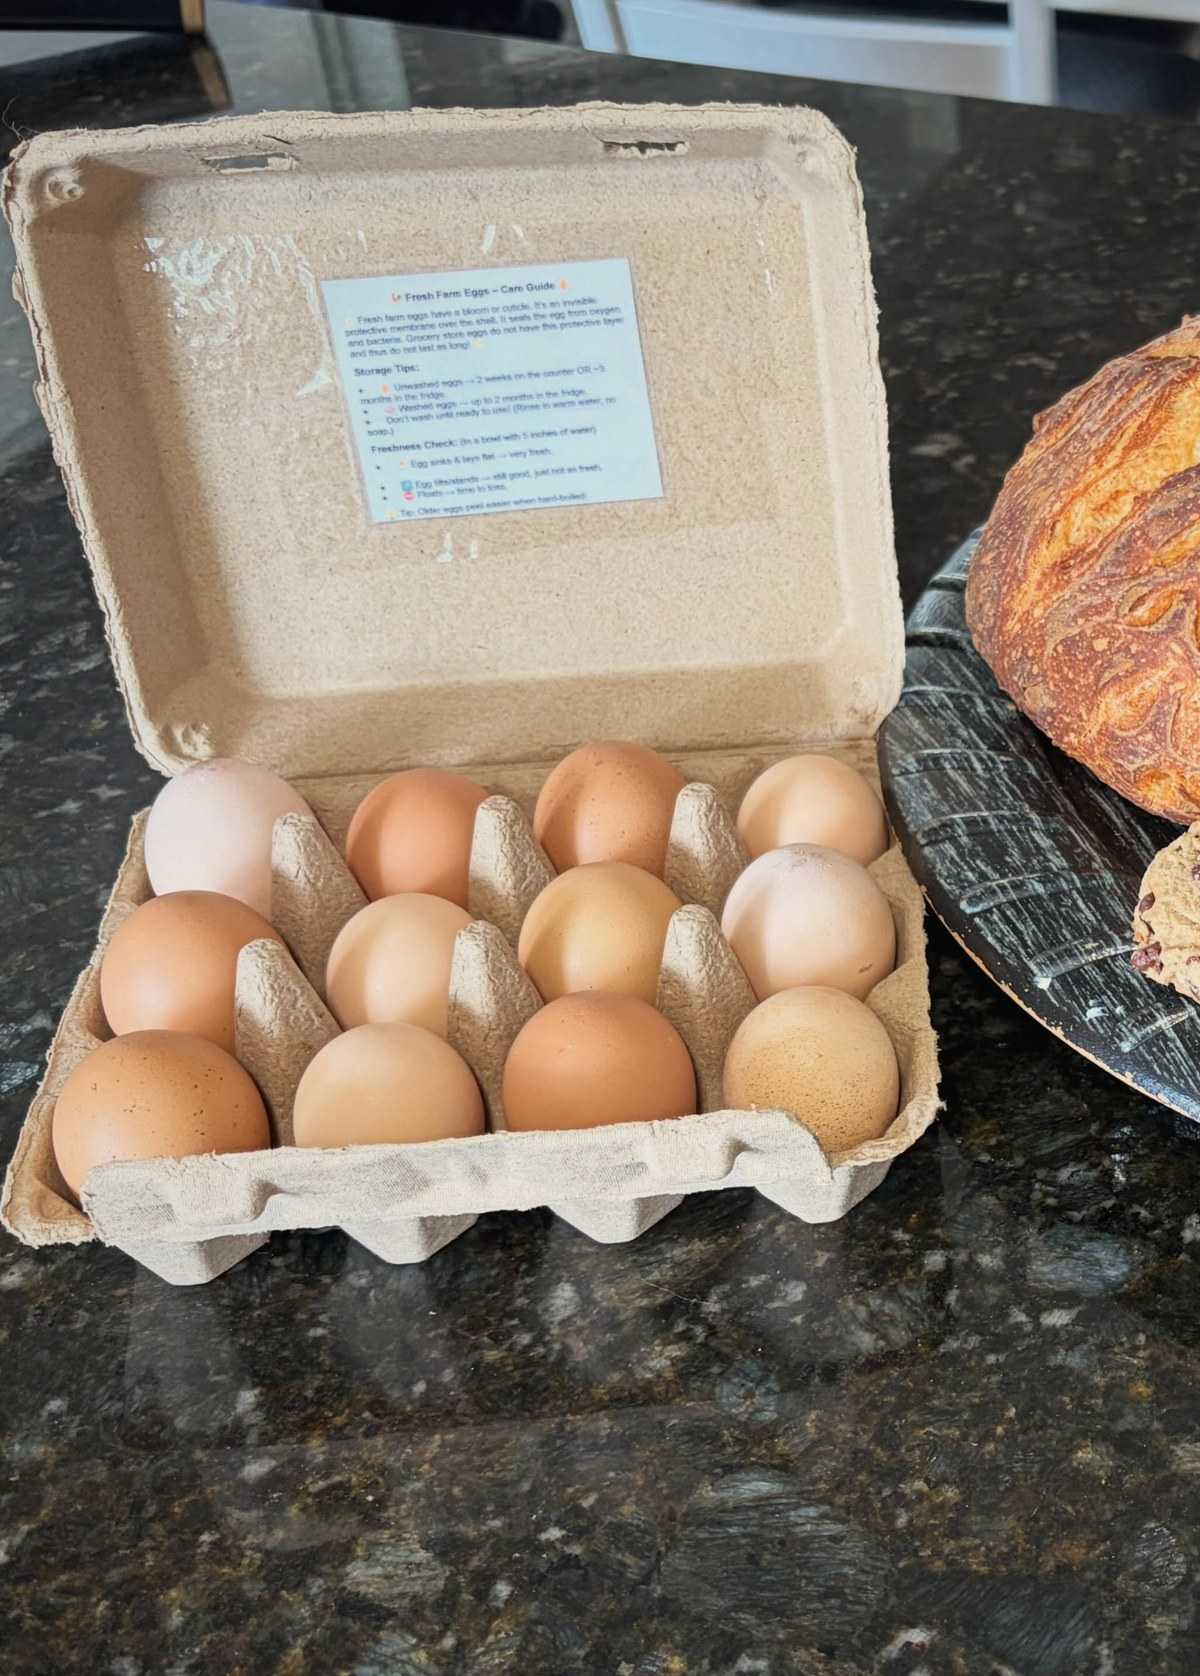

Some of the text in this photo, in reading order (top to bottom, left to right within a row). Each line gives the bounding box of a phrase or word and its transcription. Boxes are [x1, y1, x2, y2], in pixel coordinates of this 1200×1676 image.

[405, 291, 434, 301] Fresh
[436, 289, 461, 299] Farm
[464, 286, 490, 298] Eggs
[500, 284, 524, 294] Care
[526, 281, 556, 292] Guide
[357, 314, 384, 324] Fresh
[384, 313, 405, 322] farm
[407, 312, 429, 321] eggs
[430, 309, 452, 318] have
[462, 306, 489, 315] bloom
[562, 297, 597, 307] invisible
[344, 325, 388, 338] protective
[389, 321, 436, 332] membrane
[459, 318, 474, 326] the
[532, 312, 547, 320] the
[549, 312, 566, 320] egg
[567, 309, 588, 317] from
[589, 307, 622, 317] oxygen
[347, 316, 625, 347] and bacteria. Grocery store eggs do not have this protective layer
[349, 350, 367, 358] and
[368, 348, 387, 357] thus
[389, 347, 401, 355] do
[403, 346, 417, 354] not
[418, 344, 435, 353] last
[353, 363, 420, 378] Storage Tips:
[394, 380, 440, 391] Unwashed
[441, 379, 463, 388] eggs
[485, 374, 512, 383] weeks
[527, 371, 541, 379] the
[543, 368, 576, 378] counter
[577, 366, 592, 375] OR
[360, 395, 392, 405] months
[404, 393, 418, 401] the
[399, 402, 433, 412] Washed
[435, 402, 457, 410] eggs
[470, 399, 482, 407] up
[502, 393, 534, 403] months
[545, 391, 560, 399] the
[410, 412, 434, 422] wash
[435, 411, 454, 419] until
[455, 408, 481, 419] ready
[512, 403, 540, 414] (Rinse
[552, 401, 576, 409] warm
[367, 427, 395, 438] soap.)
[371, 441, 421, 454] Freshness
[424, 438, 457, 449] Check:
[480, 434, 502, 444] bowl
[502, 433, 520, 442] with
[530, 430, 558, 439] inches
[569, 426, 598, 437] water)
[410, 458, 429, 469] Egg
[430, 456, 452, 466] sinks
[481, 452, 496, 461] flat
[509, 451, 527, 460] very
[414, 479, 433, 490] Egg
[492, 472, 507, 480] still
[533, 468, 550, 478] just
[551, 467, 565, 475] not
[416, 489, 443, 498] Floats
[456, 486, 476, 495] time
[417, 506, 440, 515] Older
[443, 505, 463, 514] eggs
[465, 501, 484, 511] peel
[486, 499, 510, 508] easier
[513, 496, 536, 505] when
